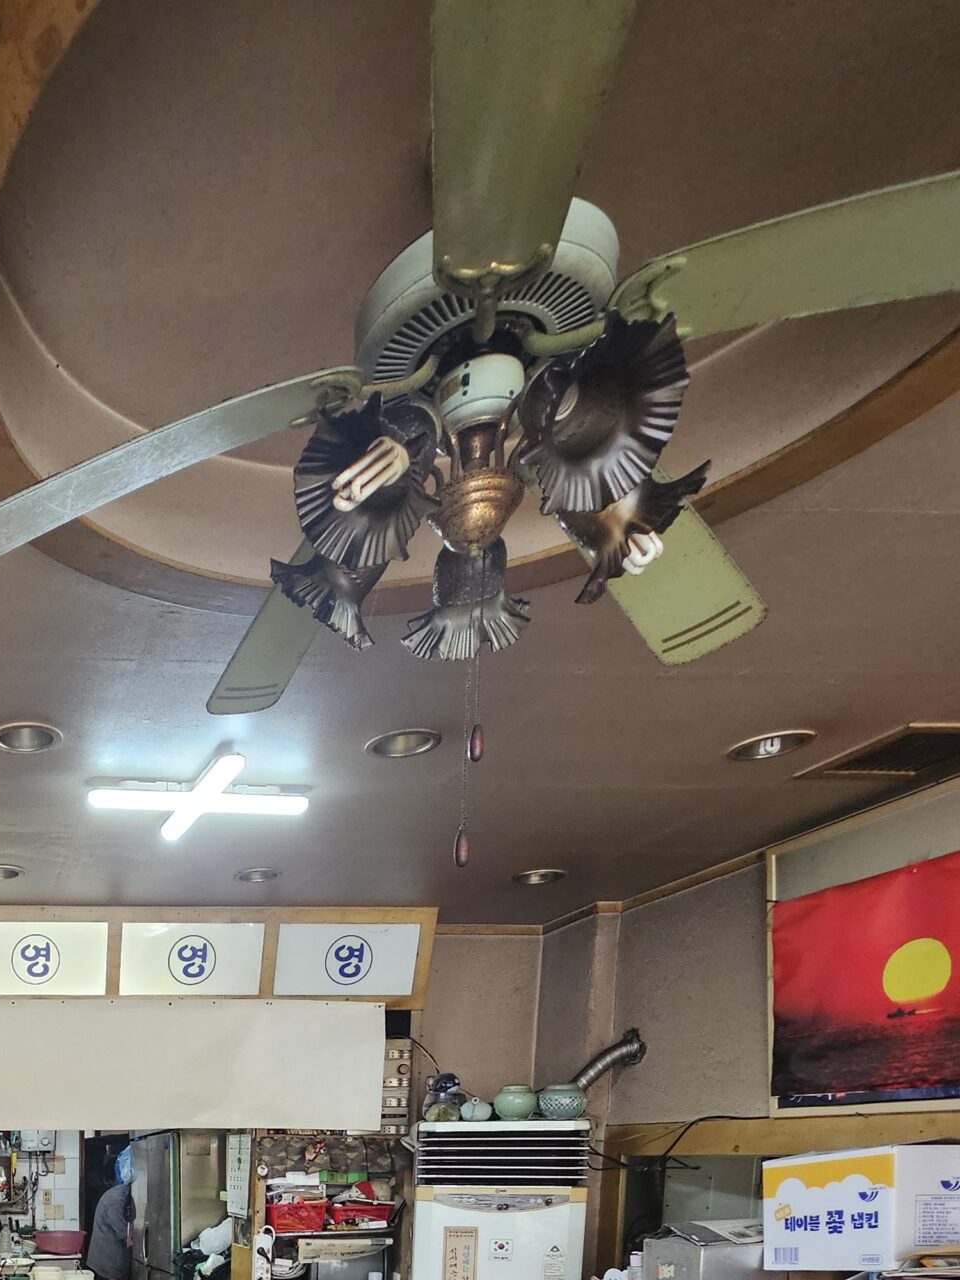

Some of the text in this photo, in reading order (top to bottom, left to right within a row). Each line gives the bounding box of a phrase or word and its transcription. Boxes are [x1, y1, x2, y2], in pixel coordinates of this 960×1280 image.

[784, 1209, 879, 1235] 테이블 꽃 냅킨
